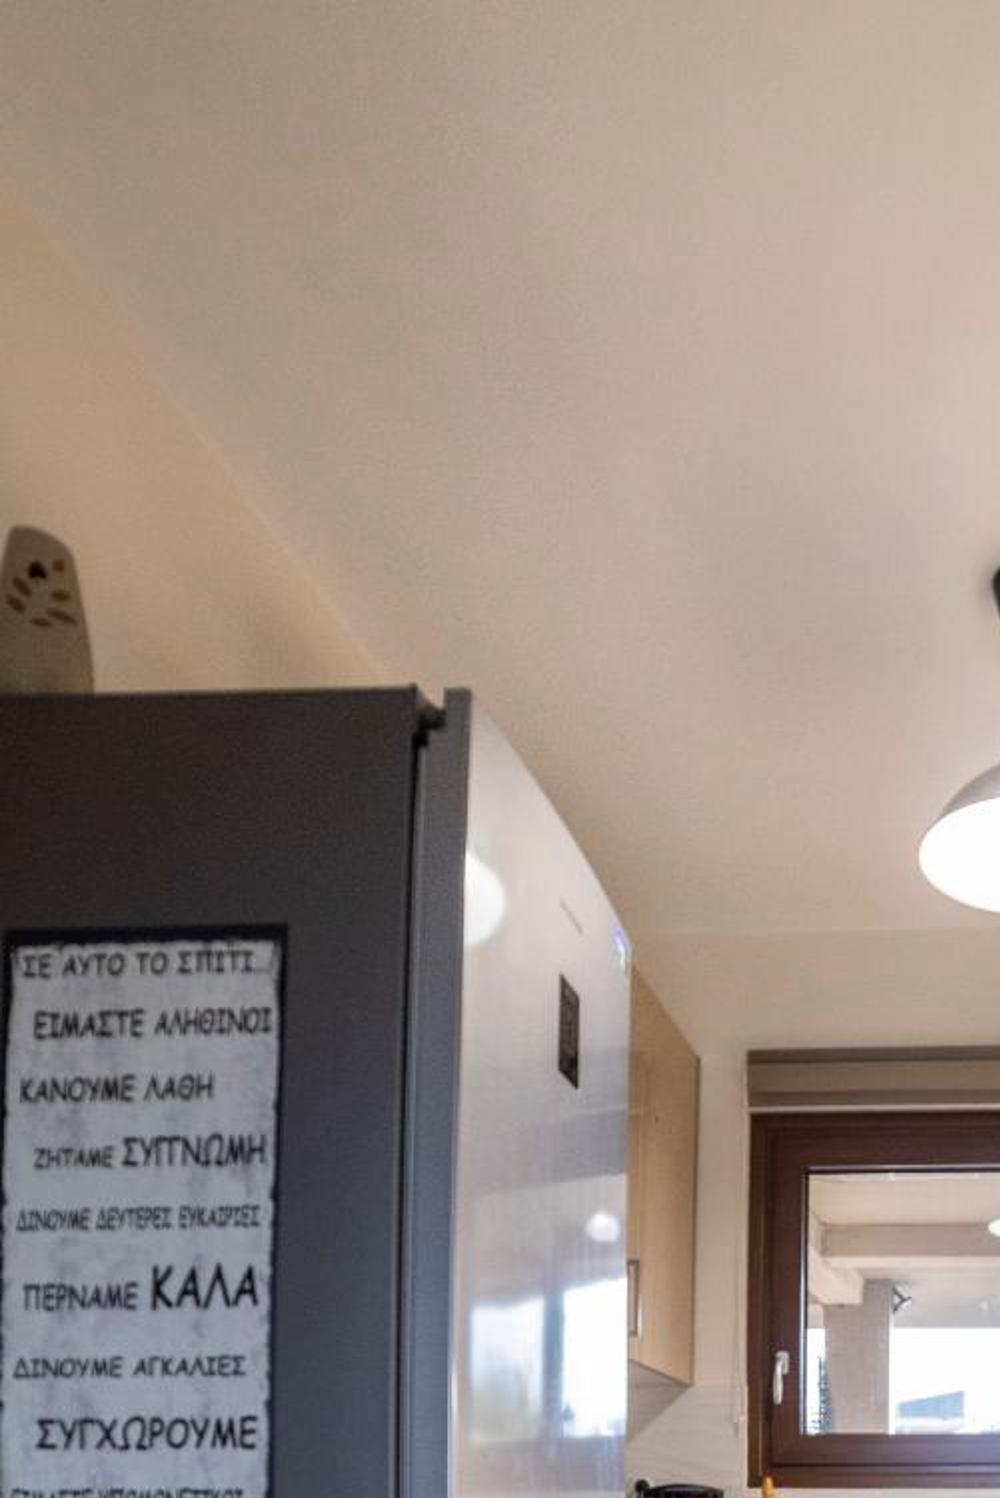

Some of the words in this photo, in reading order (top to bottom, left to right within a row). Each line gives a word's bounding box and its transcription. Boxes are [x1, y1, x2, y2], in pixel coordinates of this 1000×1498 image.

[23, 953, 52, 978] ΣΕ
[62, 952, 126, 976] ΑΥΤΟ
[136, 951, 169, 975] ΤΟ
[34, 1008, 145, 1040] ΕΙΜΑΣΤΕ
[154, 1006, 272, 1036] ΑΛΗΘΙΝΟΙ
[20, 1073, 136, 1103] ΚΑΝΟΥΜΕ
[144, 1072, 215, 1101] ΛΑΘΗ
[34, 1146, 114, 1170] ΖΗΤΑΜΕ
[121, 1133, 266, 1168] ΣΥΓΓΝΩΜΗ
[16, 1208, 91, 1232] ΔΙΝΟΥΜΕ
[96, 1206, 172, 1231] ΔΕΥΤΕΡΕΣ
[23, 1281, 138, 1312] ΠΕΡΝΑΜΕ
[151, 1262, 259, 1311] ΚΑΛΑ
[12, 1356, 123, 1379] ΔΙΝΟΥΜΕ
[133, 1355, 246, 1377] ΑΓΚΑΛΙΕΣ
[35, 1415, 258, 1451] ΣΥΓΧΩΡΟΥΜΕ
